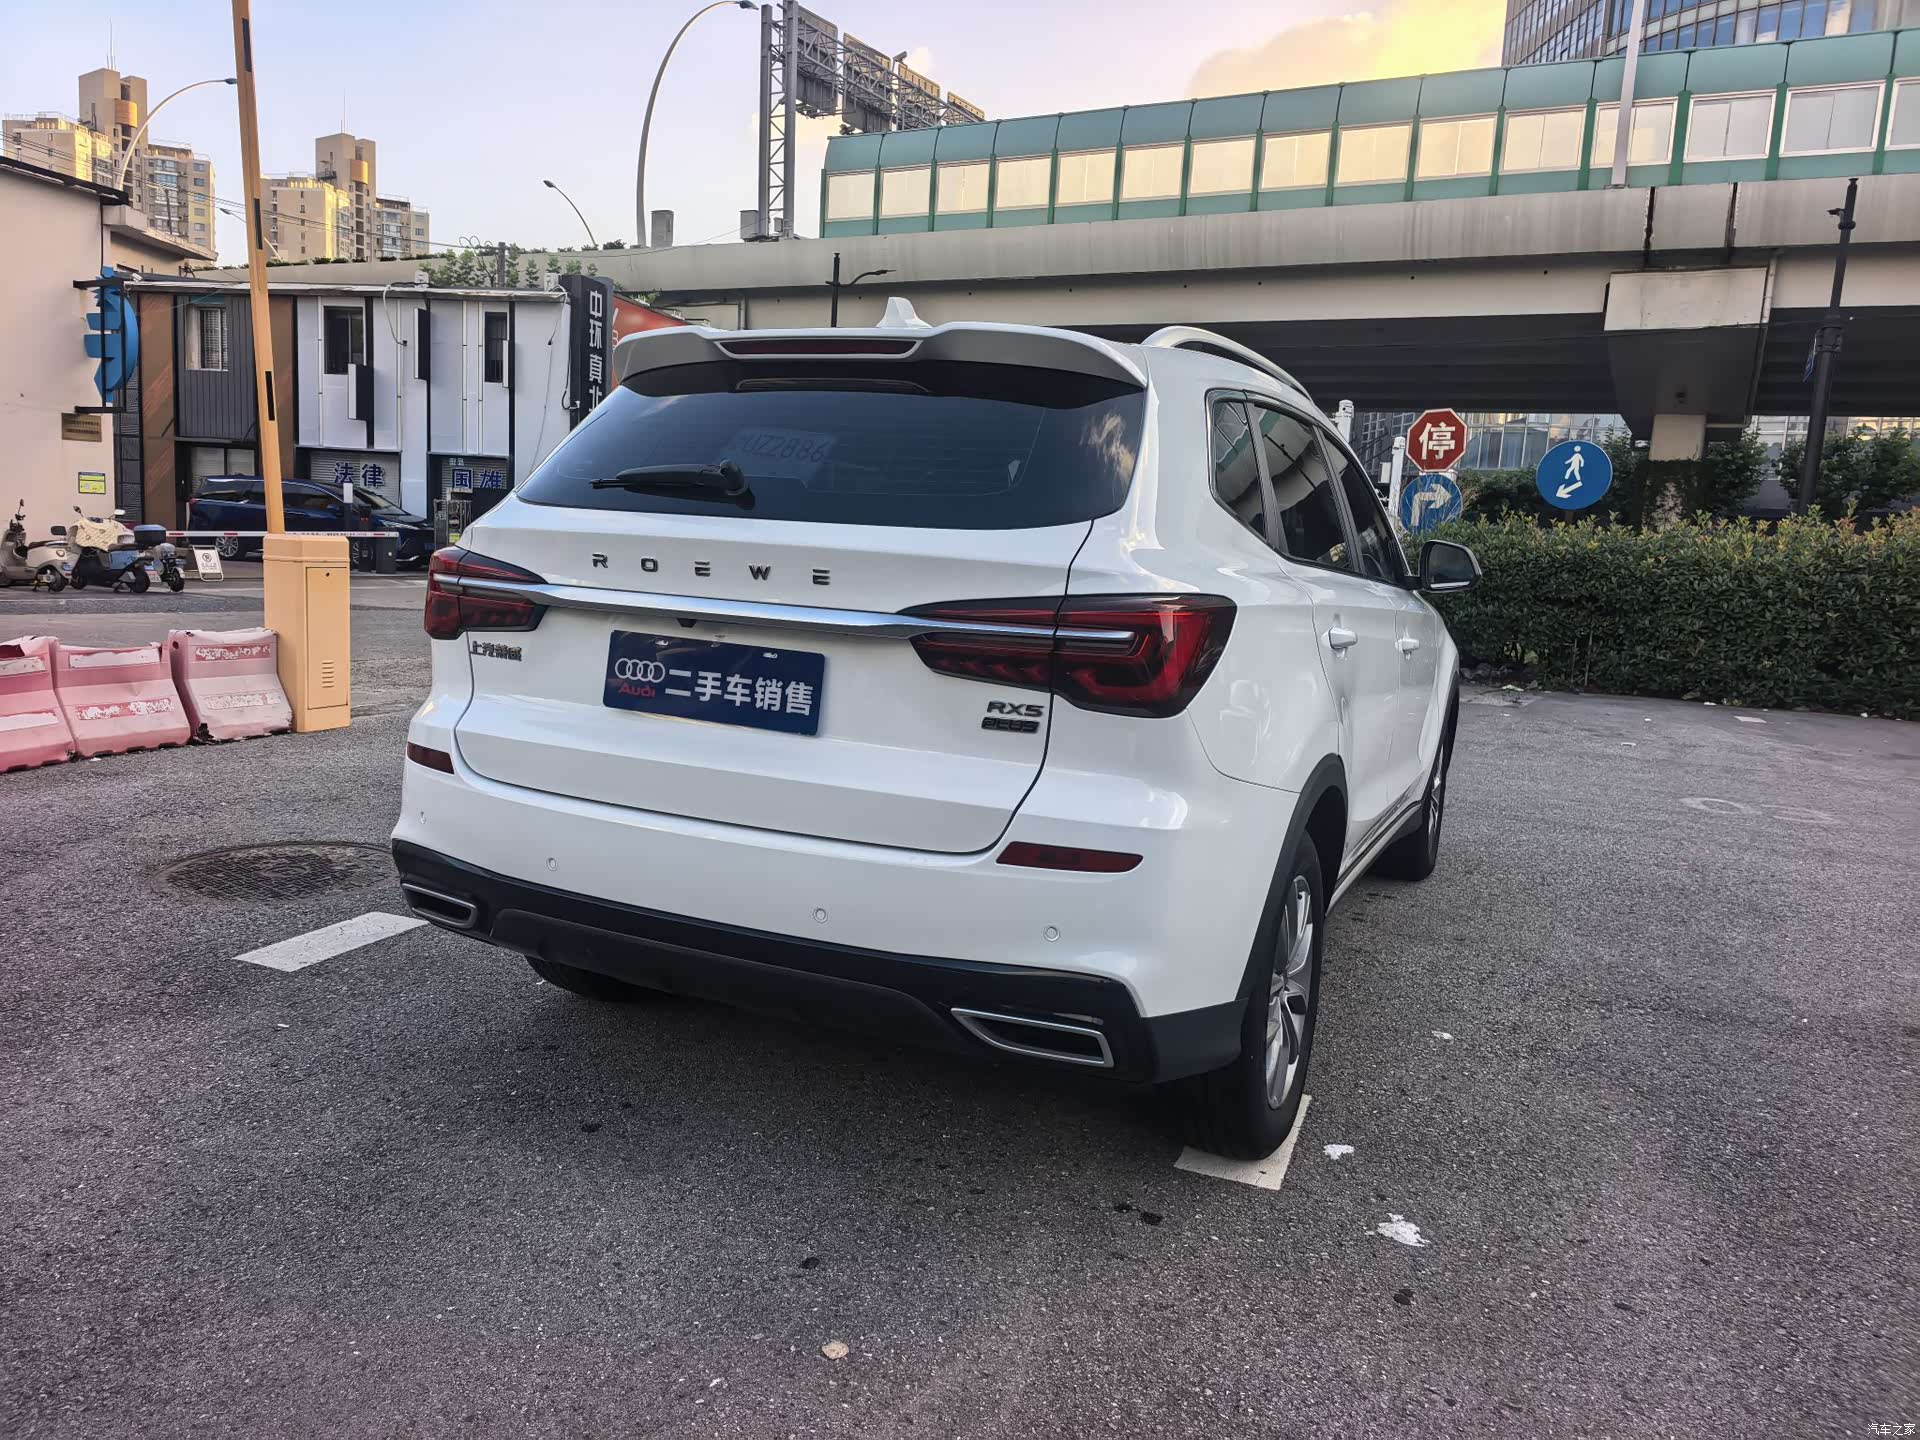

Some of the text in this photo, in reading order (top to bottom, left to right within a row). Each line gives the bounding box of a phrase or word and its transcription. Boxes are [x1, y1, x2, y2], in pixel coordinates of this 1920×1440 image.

[1419, 421, 1456, 460] 停
[334, 462, 385, 488] 法律
[592, 553, 831, 586] ROEWE
[618, 684, 656, 698] Audi
[665, 668, 814, 716] 二手车销售
[987, 701, 1045, 717] RX5
